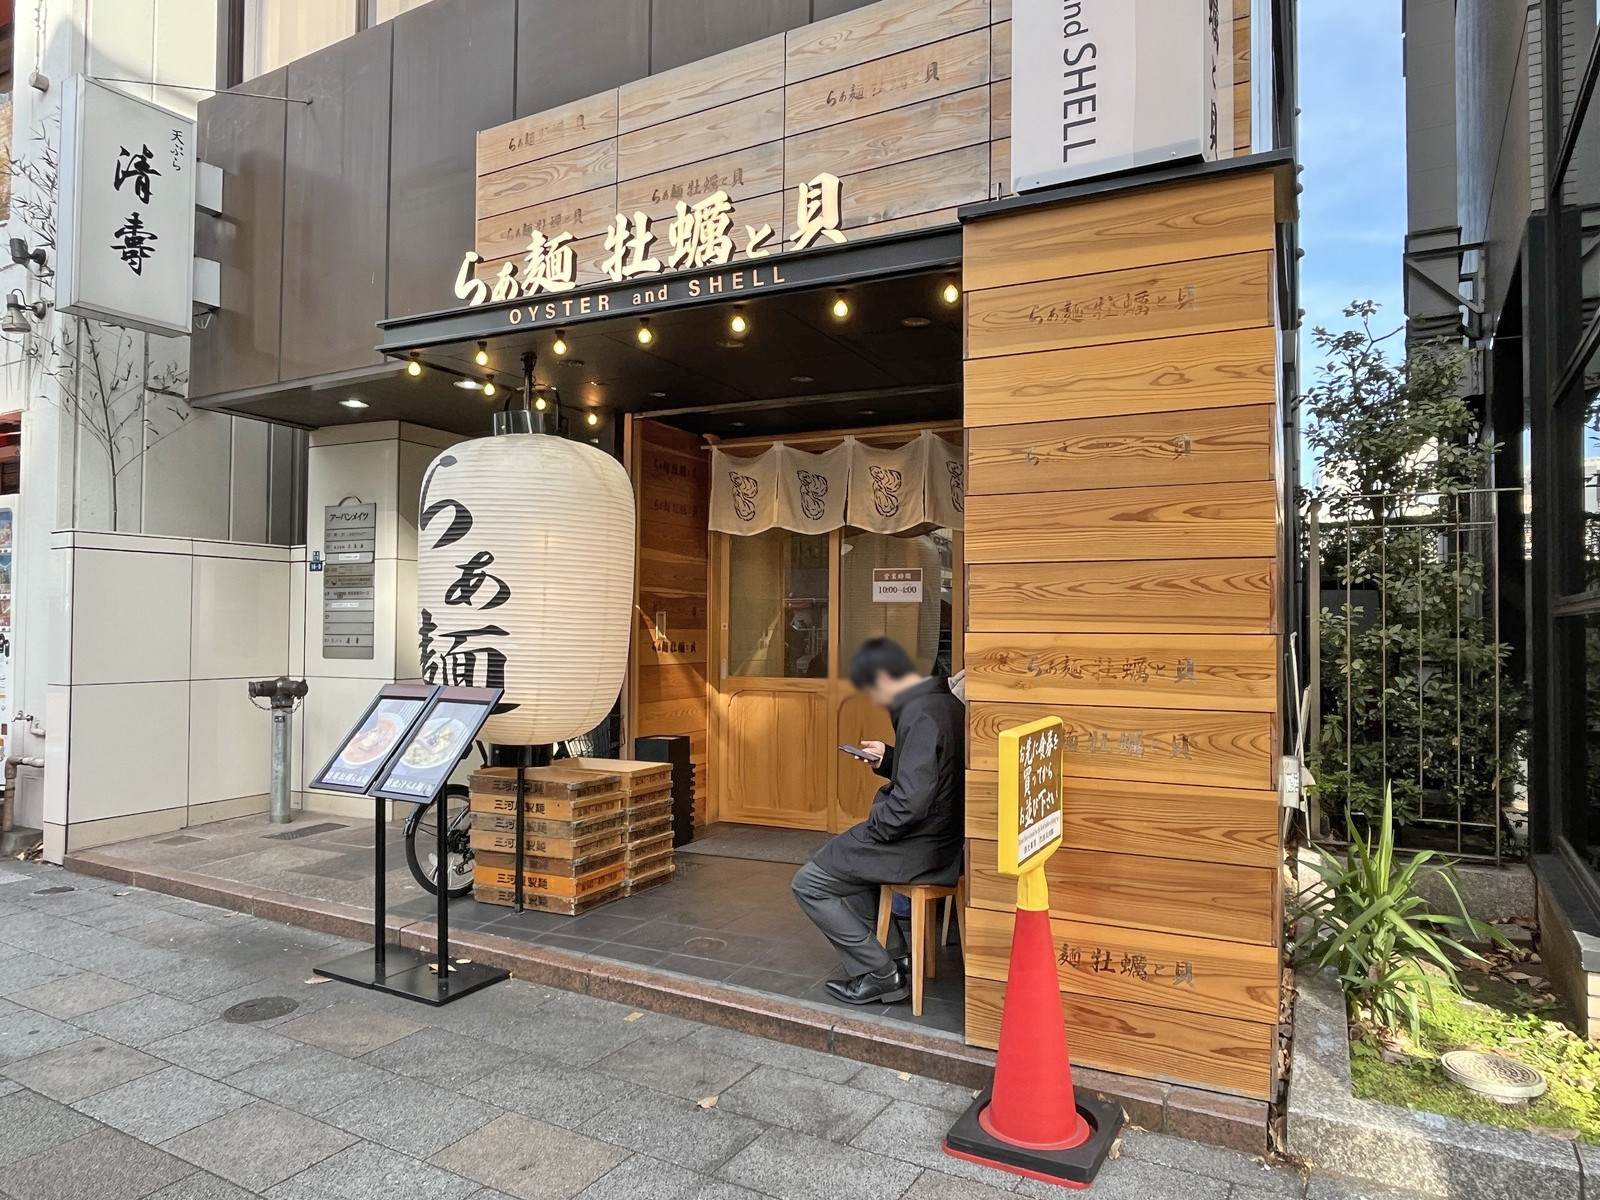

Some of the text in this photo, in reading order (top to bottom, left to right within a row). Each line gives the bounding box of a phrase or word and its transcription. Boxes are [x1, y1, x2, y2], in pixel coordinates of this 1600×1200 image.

[1063, 0, 1097, 163] nd SHELL
[170, 129, 185, 171] 天ぷら
[508, 266, 787, 326] OYSTER and SHELL
[329, 512, 369, 523] アーバンメイツ
[1023, 762, 1054, 797] 買ってから
[1019, 787, 1059, 828] お並び下さい
[494, 837, 547, 853] 三河製麺
